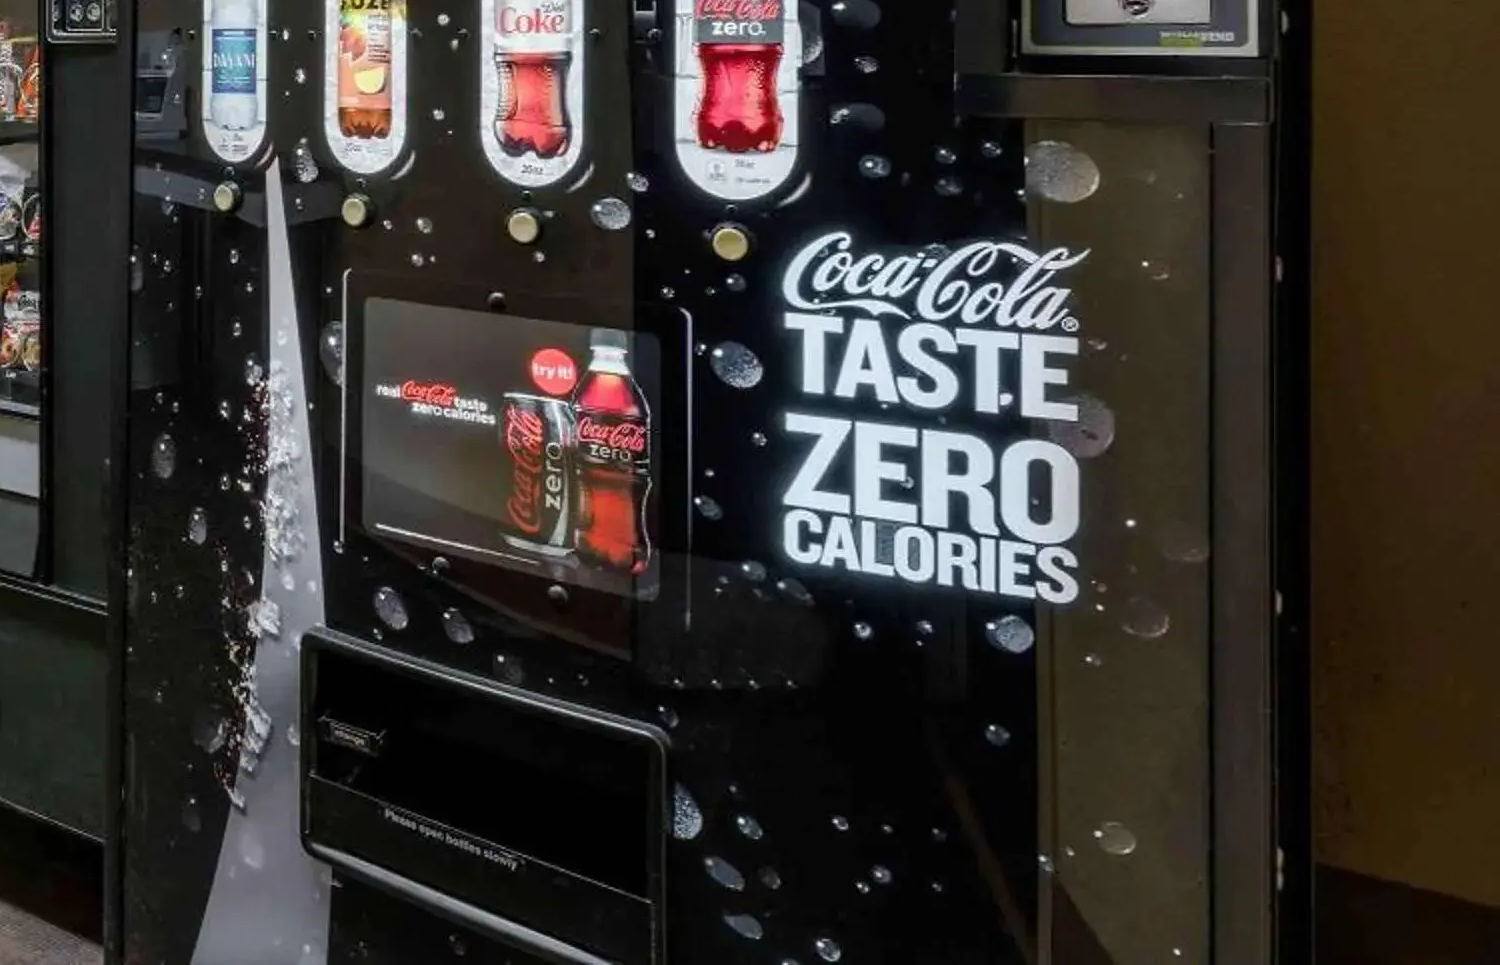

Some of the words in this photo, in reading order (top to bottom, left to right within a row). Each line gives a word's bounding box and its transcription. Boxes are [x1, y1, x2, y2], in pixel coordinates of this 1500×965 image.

[499, 7, 565, 36] Coke
[711, 19, 766, 37] zero
[782, 231, 1091, 330] Coca-Cola
[532, 362, 556, 380] try
[784, 312, 1080, 422] TASTE
[376, 383, 400, 398] real
[401, 380, 457, 406] Coca-Cola
[454, 396, 488, 412] taste
[411, 402, 441, 417] zero
[443, 406, 497, 426] calories
[577, 417, 646, 451] Coca-Cola
[506, 407, 544, 533] Coca-Cola
[589, 444, 632, 463] zero
[545, 441, 565, 510] zero
[783, 412, 1081, 544] ZERO
[784, 509, 1080, 604] CALORIES
[384, 808, 417, 831] Please
